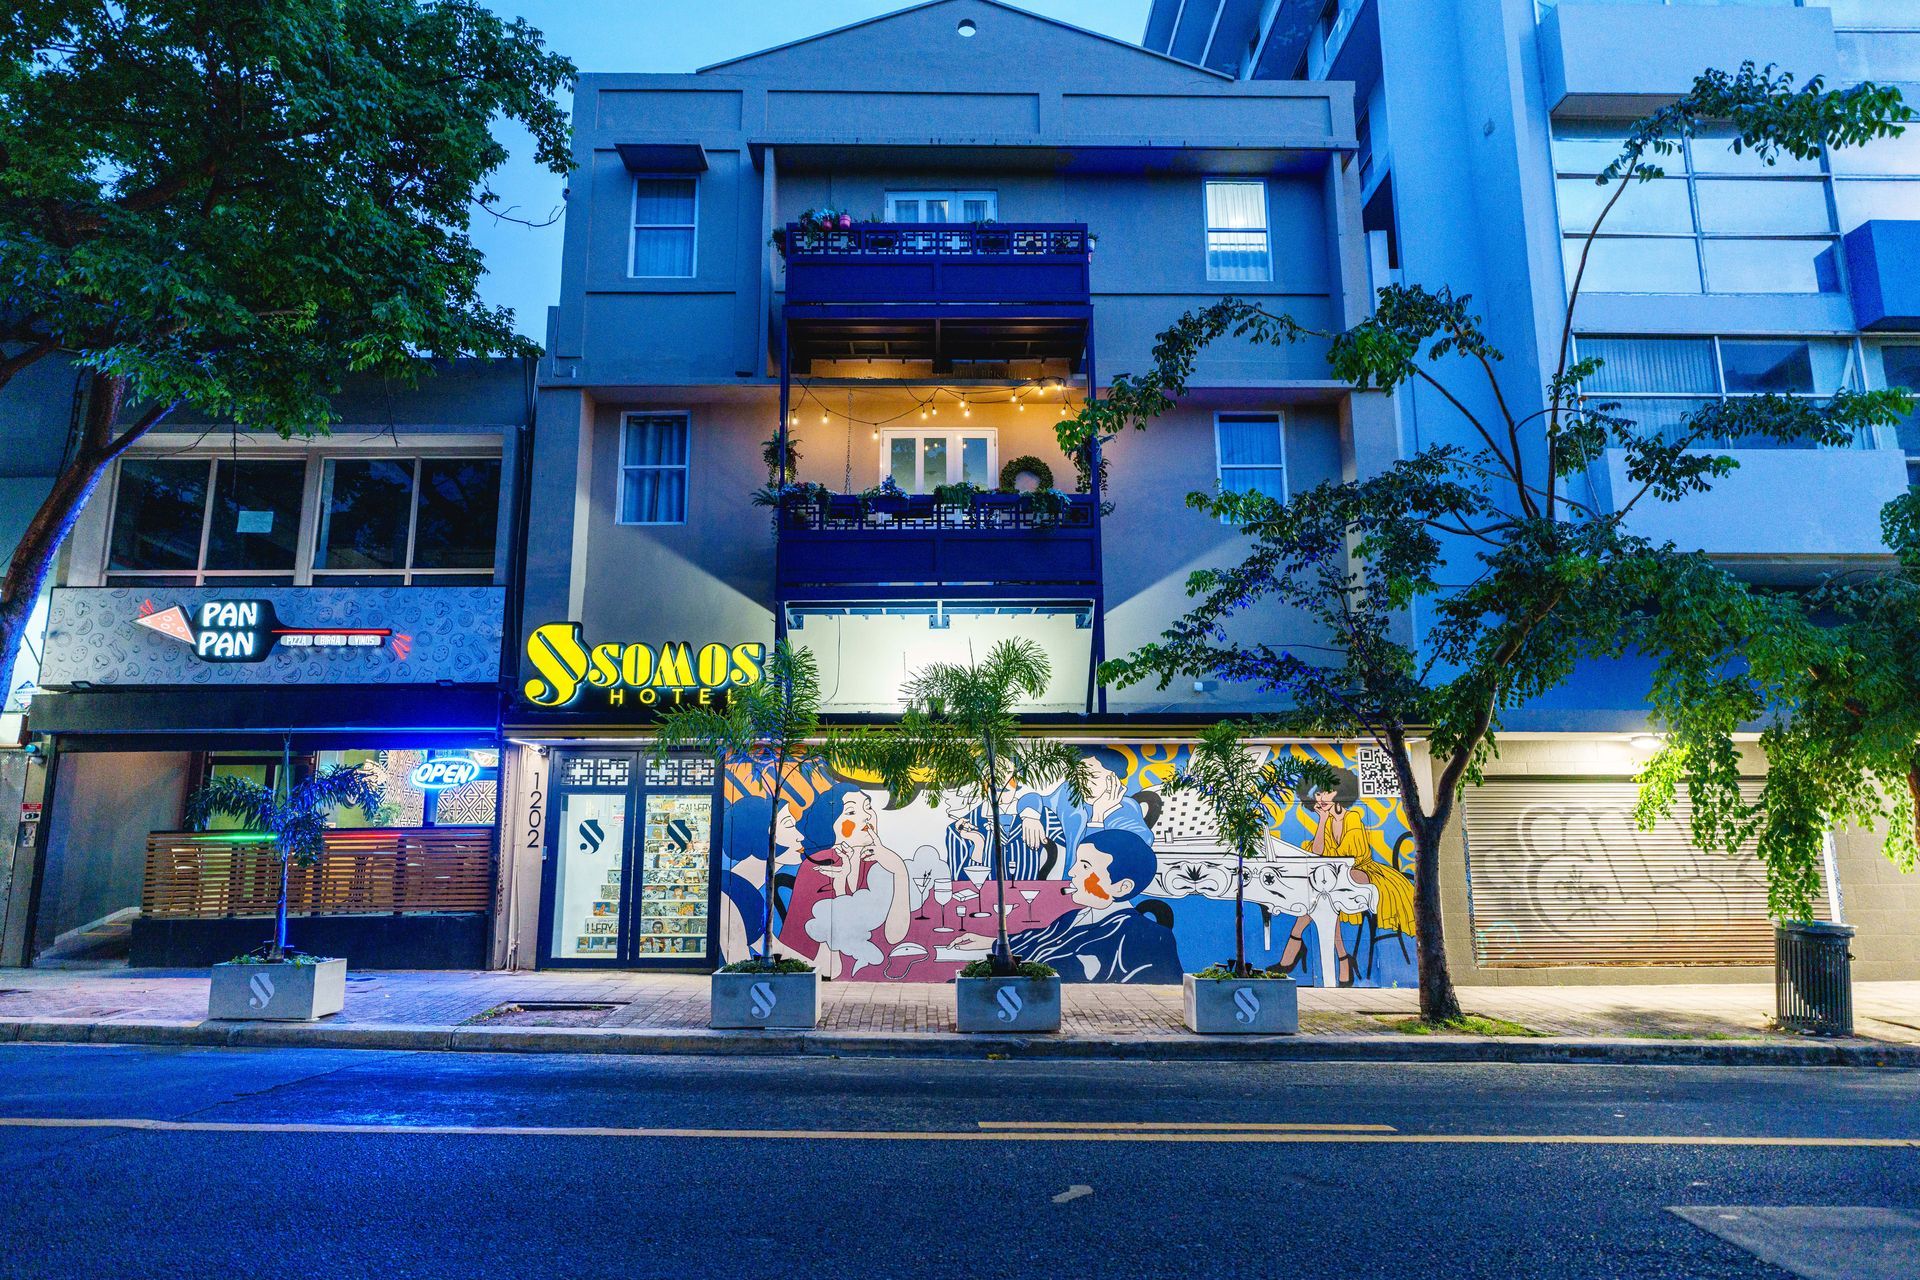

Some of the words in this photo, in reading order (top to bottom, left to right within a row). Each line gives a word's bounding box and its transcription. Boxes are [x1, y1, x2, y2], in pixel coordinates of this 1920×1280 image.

[202, 602, 258, 627] PAN
[199, 632, 254, 656] PAN
[286, 635, 306, 646] PIZZA
[320, 635, 341, 646] BIRRA
[354, 635, 375, 645] VINOS
[588, 642, 760, 688] SOMOS
[610, 689, 738, 705] HOTEL
[416, 763, 472, 784] OPEN
[527, 772, 542, 848] 1202
